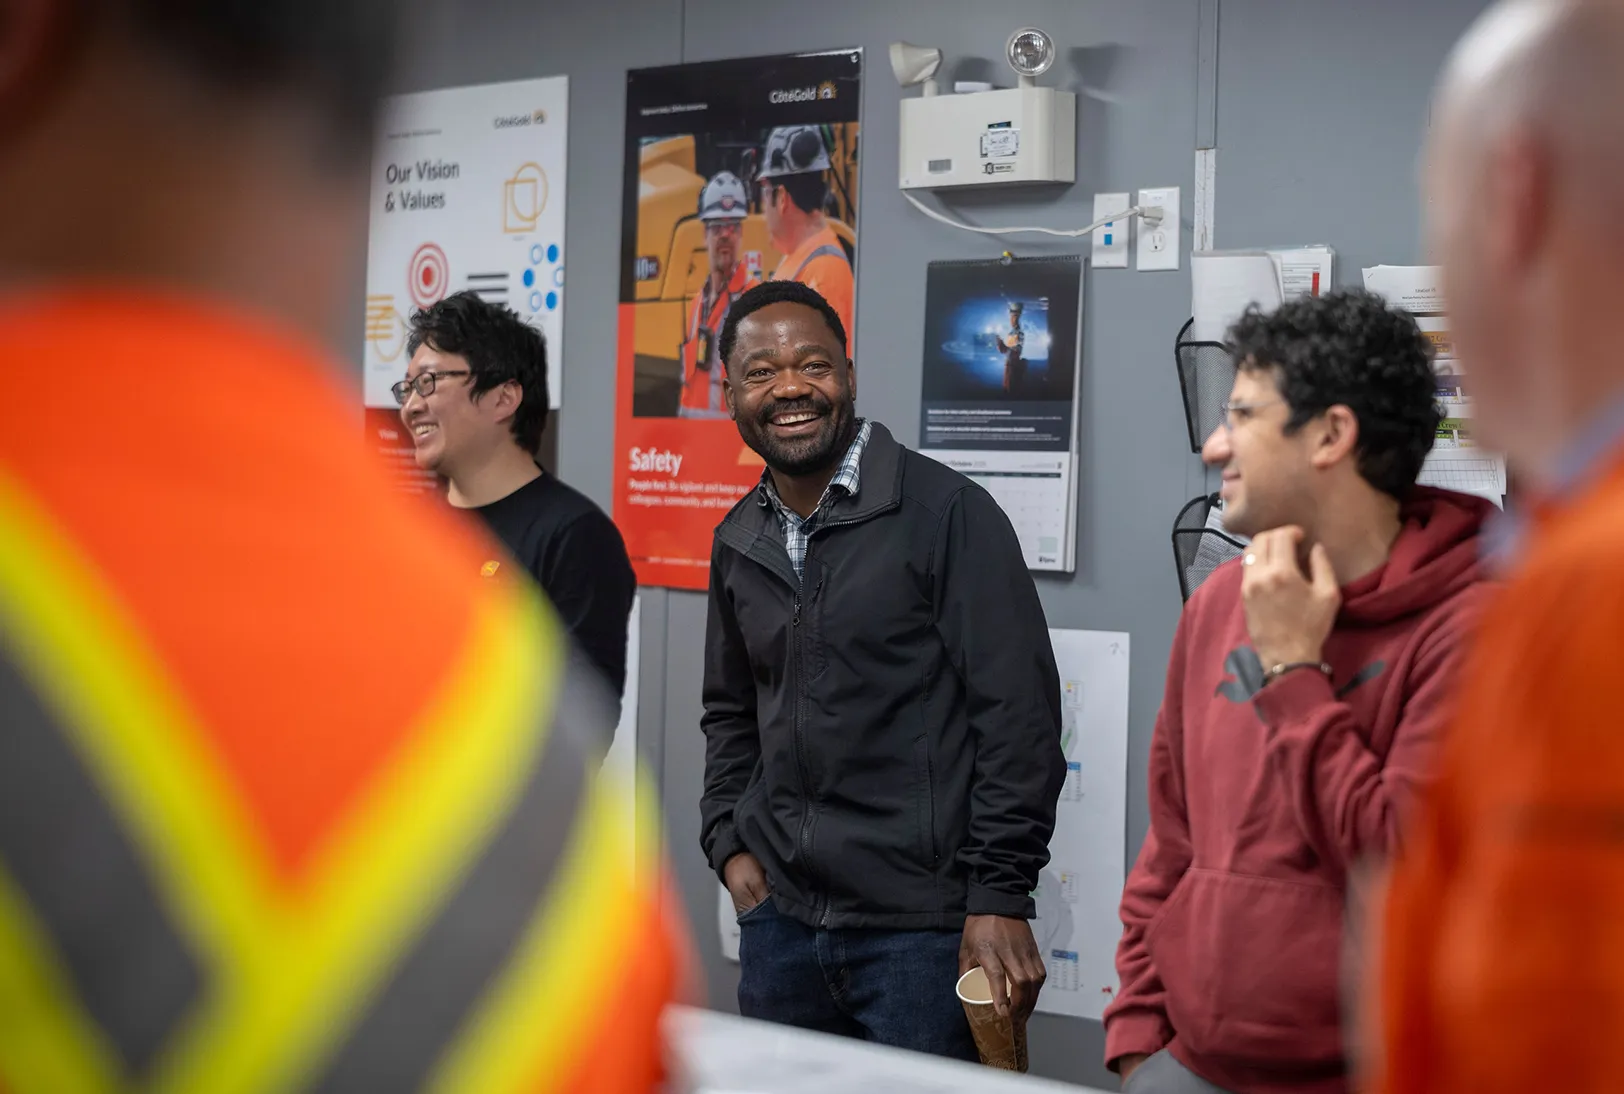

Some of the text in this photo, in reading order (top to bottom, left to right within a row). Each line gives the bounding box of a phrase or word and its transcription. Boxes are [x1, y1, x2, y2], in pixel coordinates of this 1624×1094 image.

[386, 159, 460, 185] Our Vision
[385, 188, 447, 214] & Values
[629, 446, 682, 478] Safety
